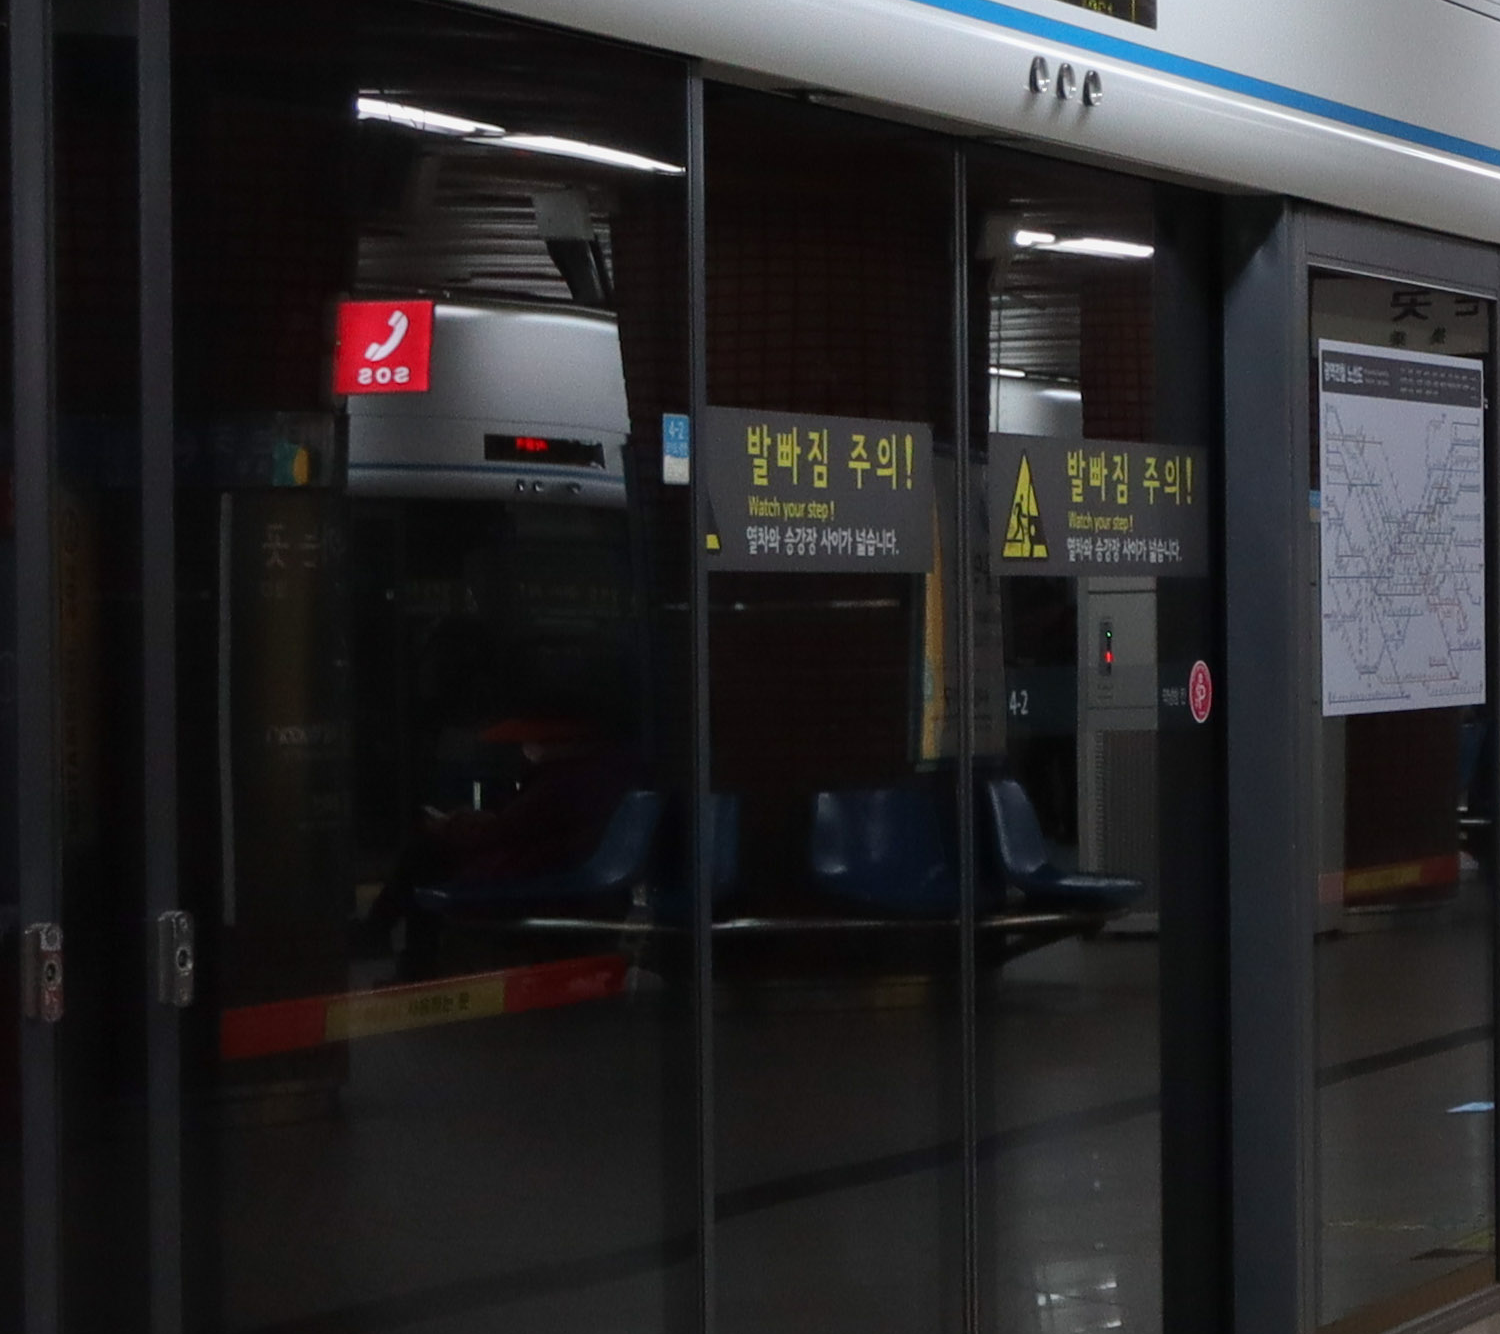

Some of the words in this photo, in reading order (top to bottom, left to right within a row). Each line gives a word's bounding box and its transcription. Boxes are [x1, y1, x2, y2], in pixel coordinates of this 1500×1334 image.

[668, 421, 685, 440] 4-2
[746, 424, 829, 488] 발빠짐
[848, 433, 914, 490] 주의!
[1067, 449, 1129, 505] 발빠짐
[1142, 455, 1193, 505] 주의!
[748, 496, 781, 517] Watch
[783, 502, 806, 521] your
[1068, 511, 1094, 531] Watch
[746, 525, 780, 555] 열차와
[784, 527, 817, 556] 승강장
[820, 528, 853, 555] 사이가
[855, 528, 900, 557] 넓습니다.
[1066, 536, 1094, 563] 열차와
[1095, 536, 1121, 563] 승강장
[1122, 538, 1147, 562] 사이가
[1148, 537, 1183, 564] 넓습니다.
